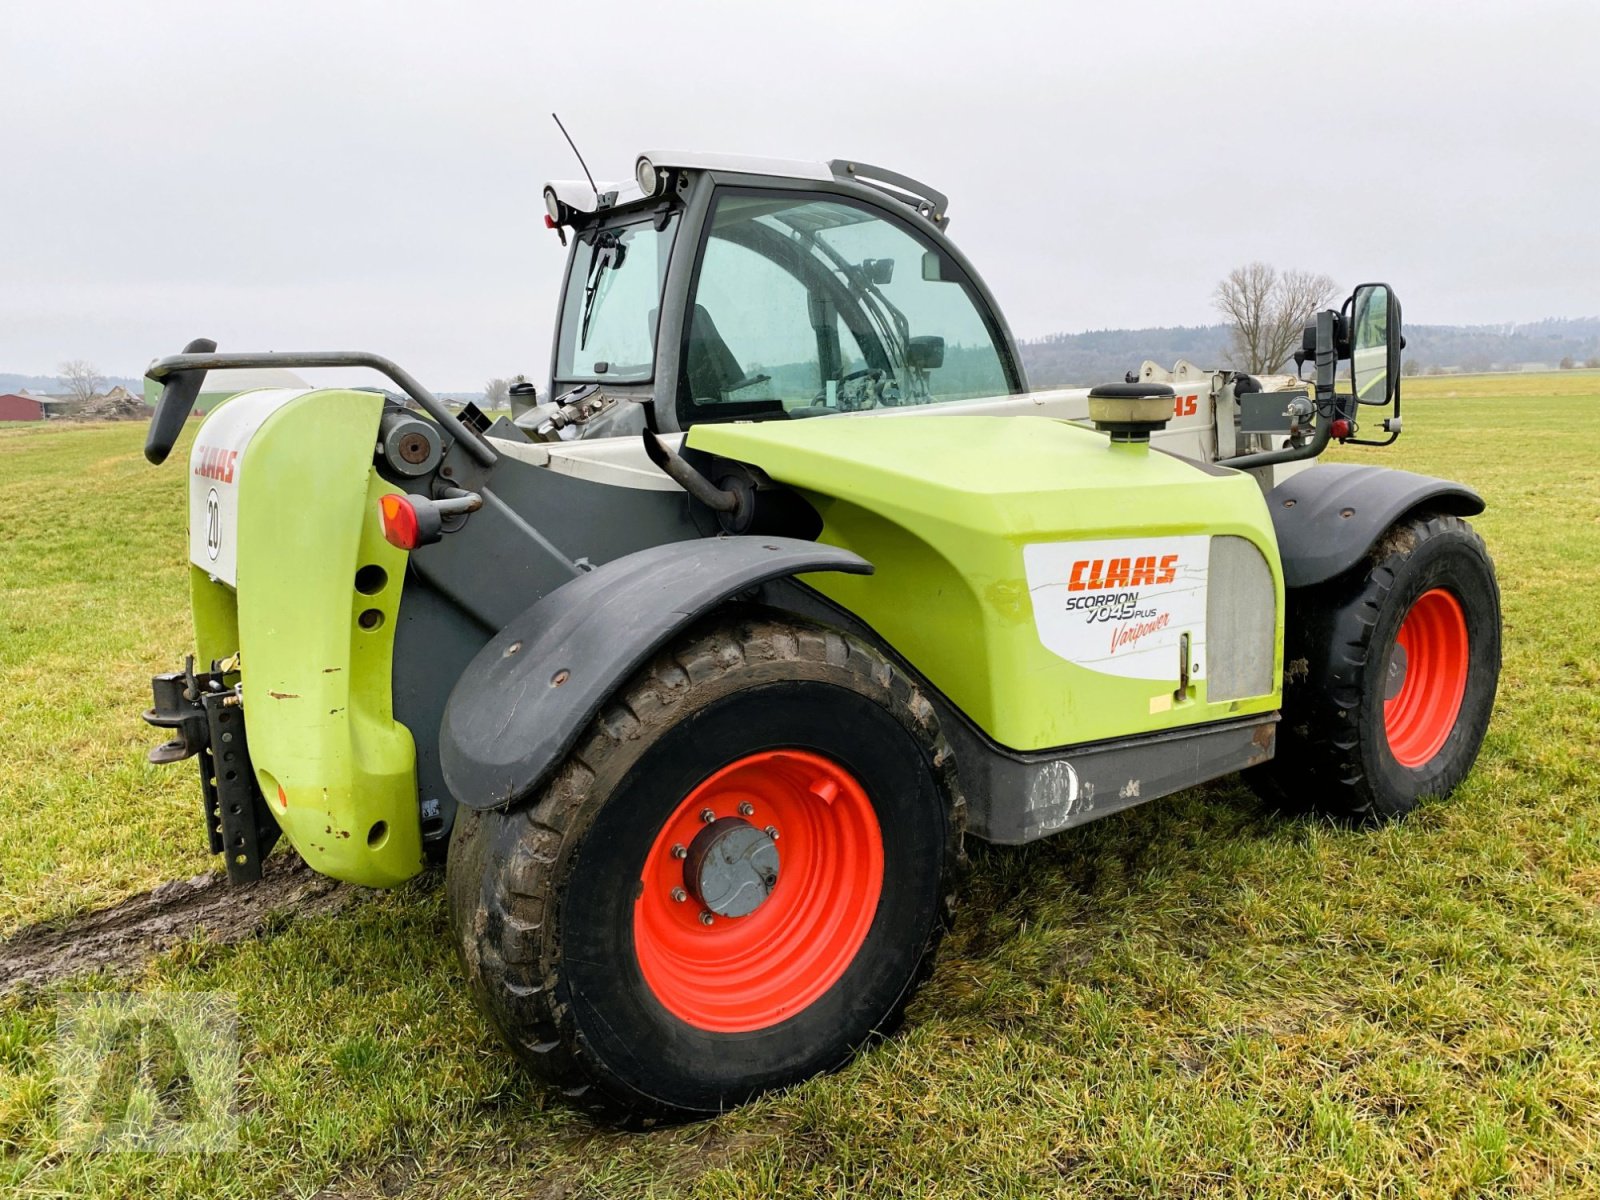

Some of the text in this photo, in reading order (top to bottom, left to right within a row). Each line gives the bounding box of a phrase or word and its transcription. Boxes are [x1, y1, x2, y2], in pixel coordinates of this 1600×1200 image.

[208, 500, 219, 549] 20
[1068, 554, 1179, 592] CLAAS
[1066, 592, 1140, 611] SCORPION
[1086, 601, 1157, 624] 7045 PLUS
[1111, 613, 1170, 654] Varipower
